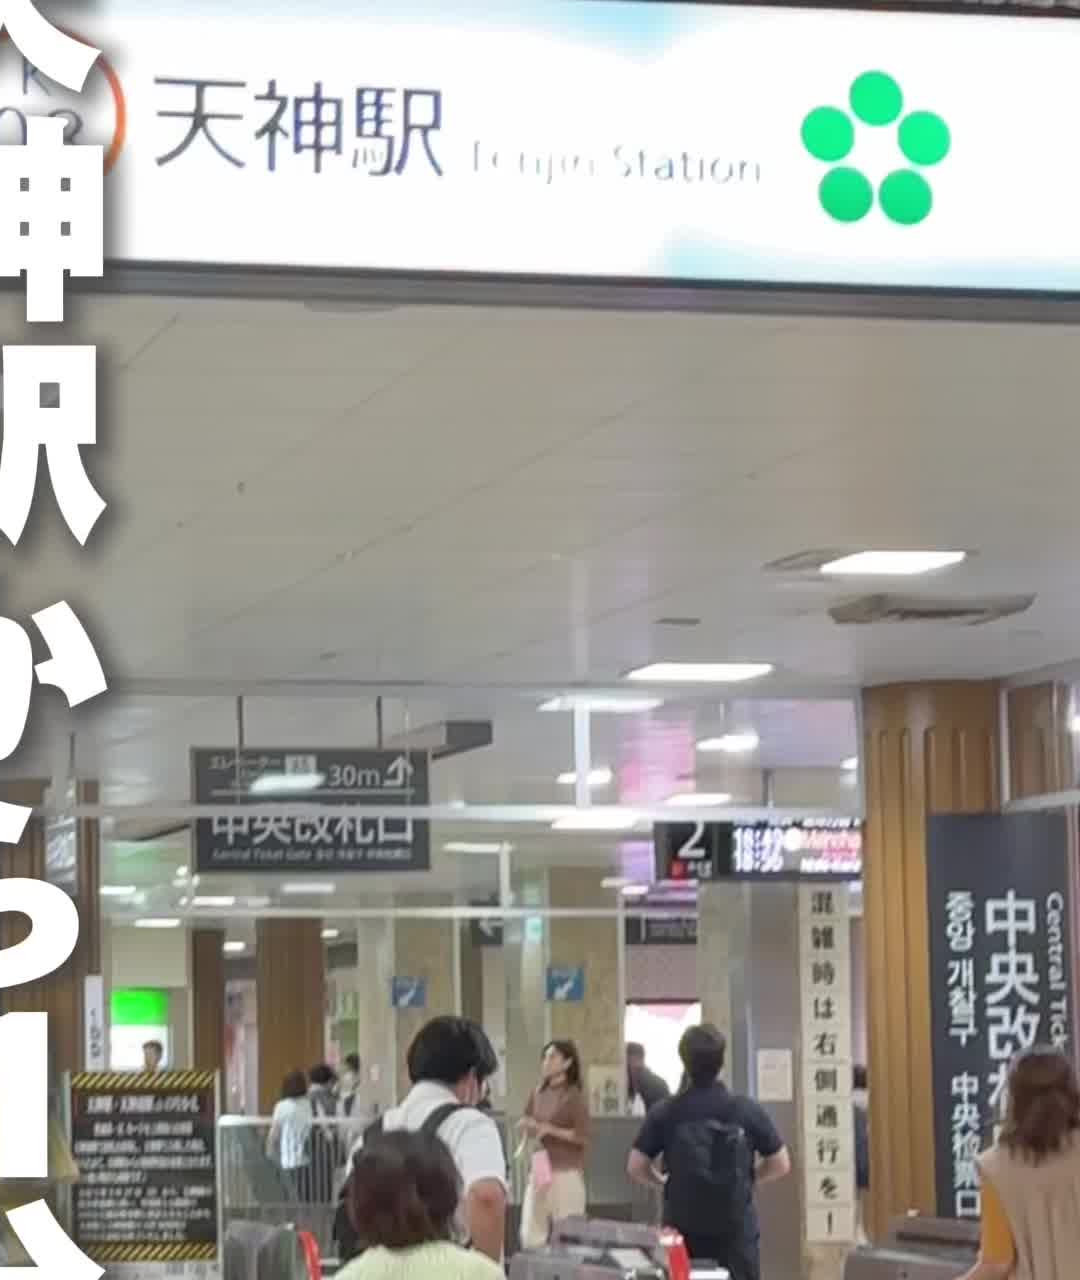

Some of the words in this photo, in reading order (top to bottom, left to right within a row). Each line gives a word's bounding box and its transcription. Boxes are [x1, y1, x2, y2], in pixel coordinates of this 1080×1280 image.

[153, 76, 445, 176] 天神駅
[612, 144, 762, 185] Station
[329, 764, 381, 788] 30m
[946, 890, 974, 953] 중앙
[1046, 890, 1067, 991] Central
